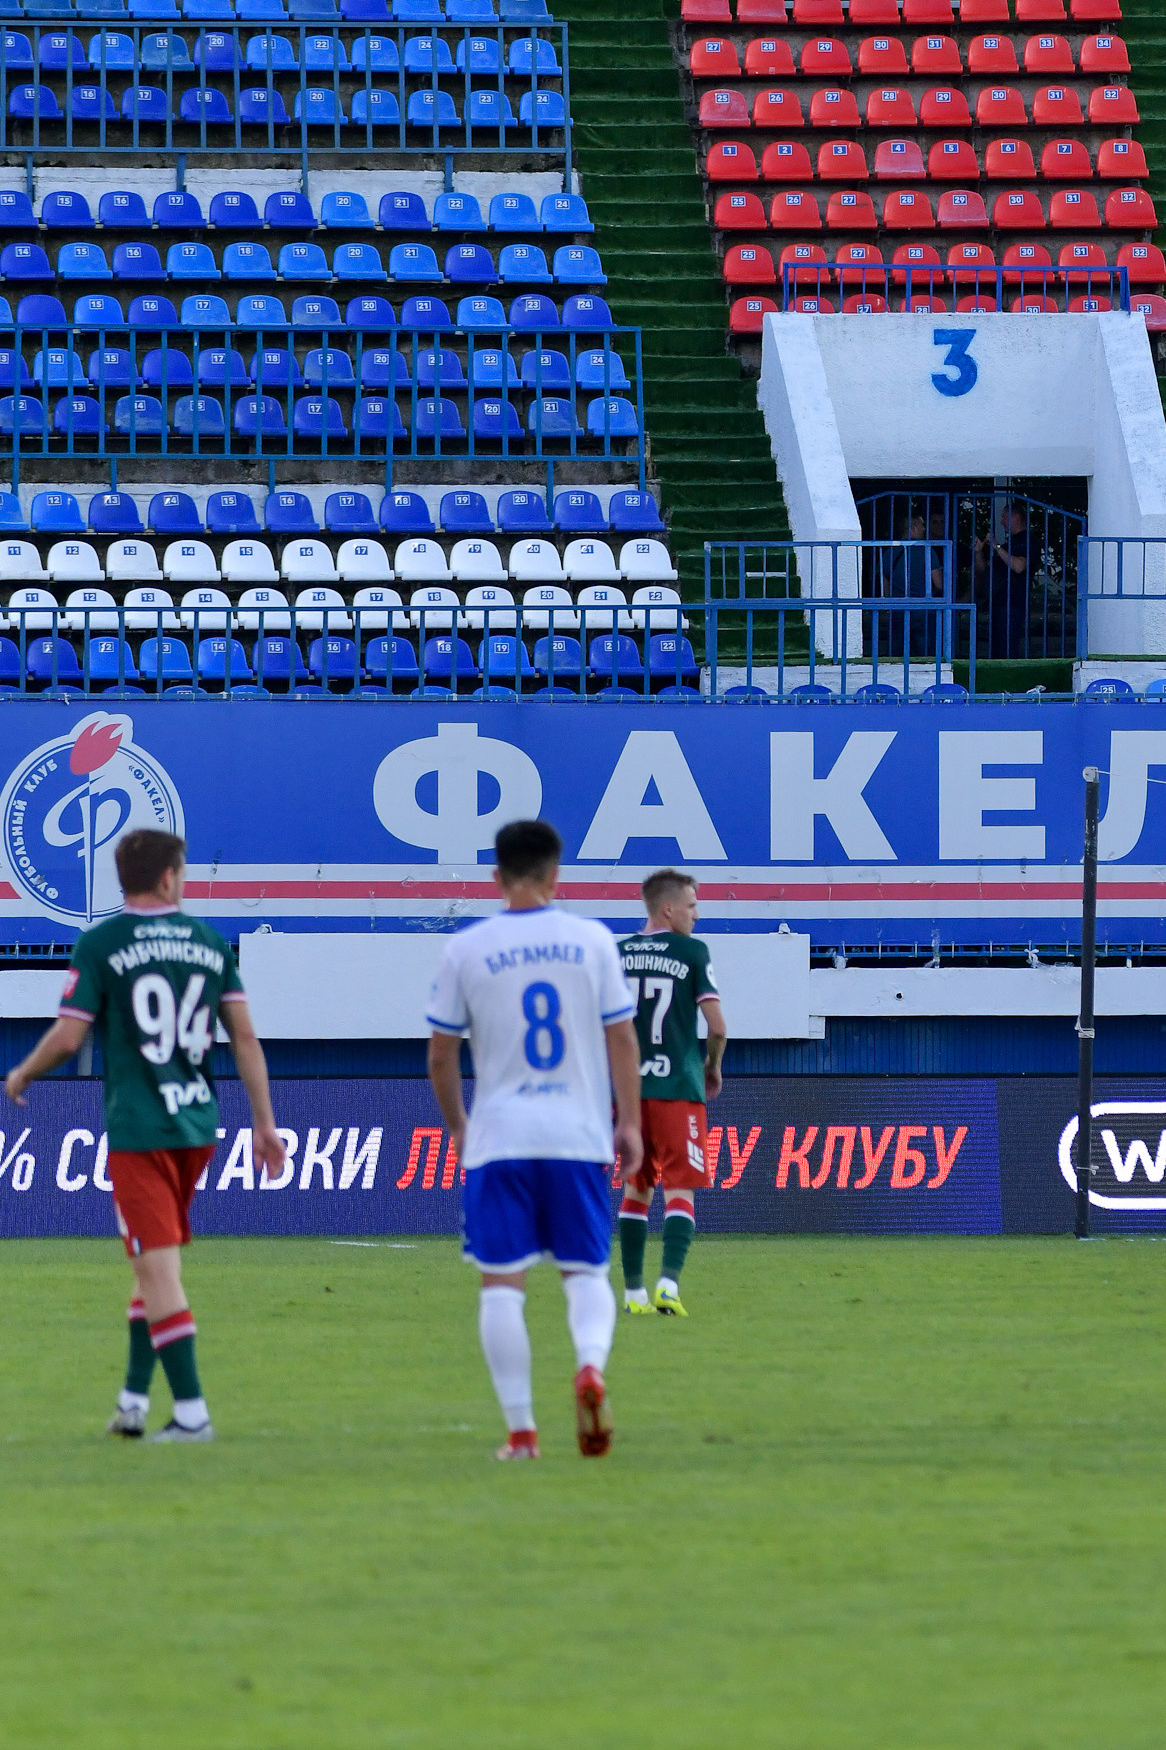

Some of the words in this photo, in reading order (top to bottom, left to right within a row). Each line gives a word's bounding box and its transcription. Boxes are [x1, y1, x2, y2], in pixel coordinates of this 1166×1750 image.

[931, 329, 978, 397] 3
[24, 759, 58, 794] КЛУБ
[12, 799, 59, 900] ФУТБОЛЬНЫЙ
[132, 973, 213, 1066] 94
[521, 980, 566, 1072] 8
[775, 1126, 969, 1190] КЛУБУ
